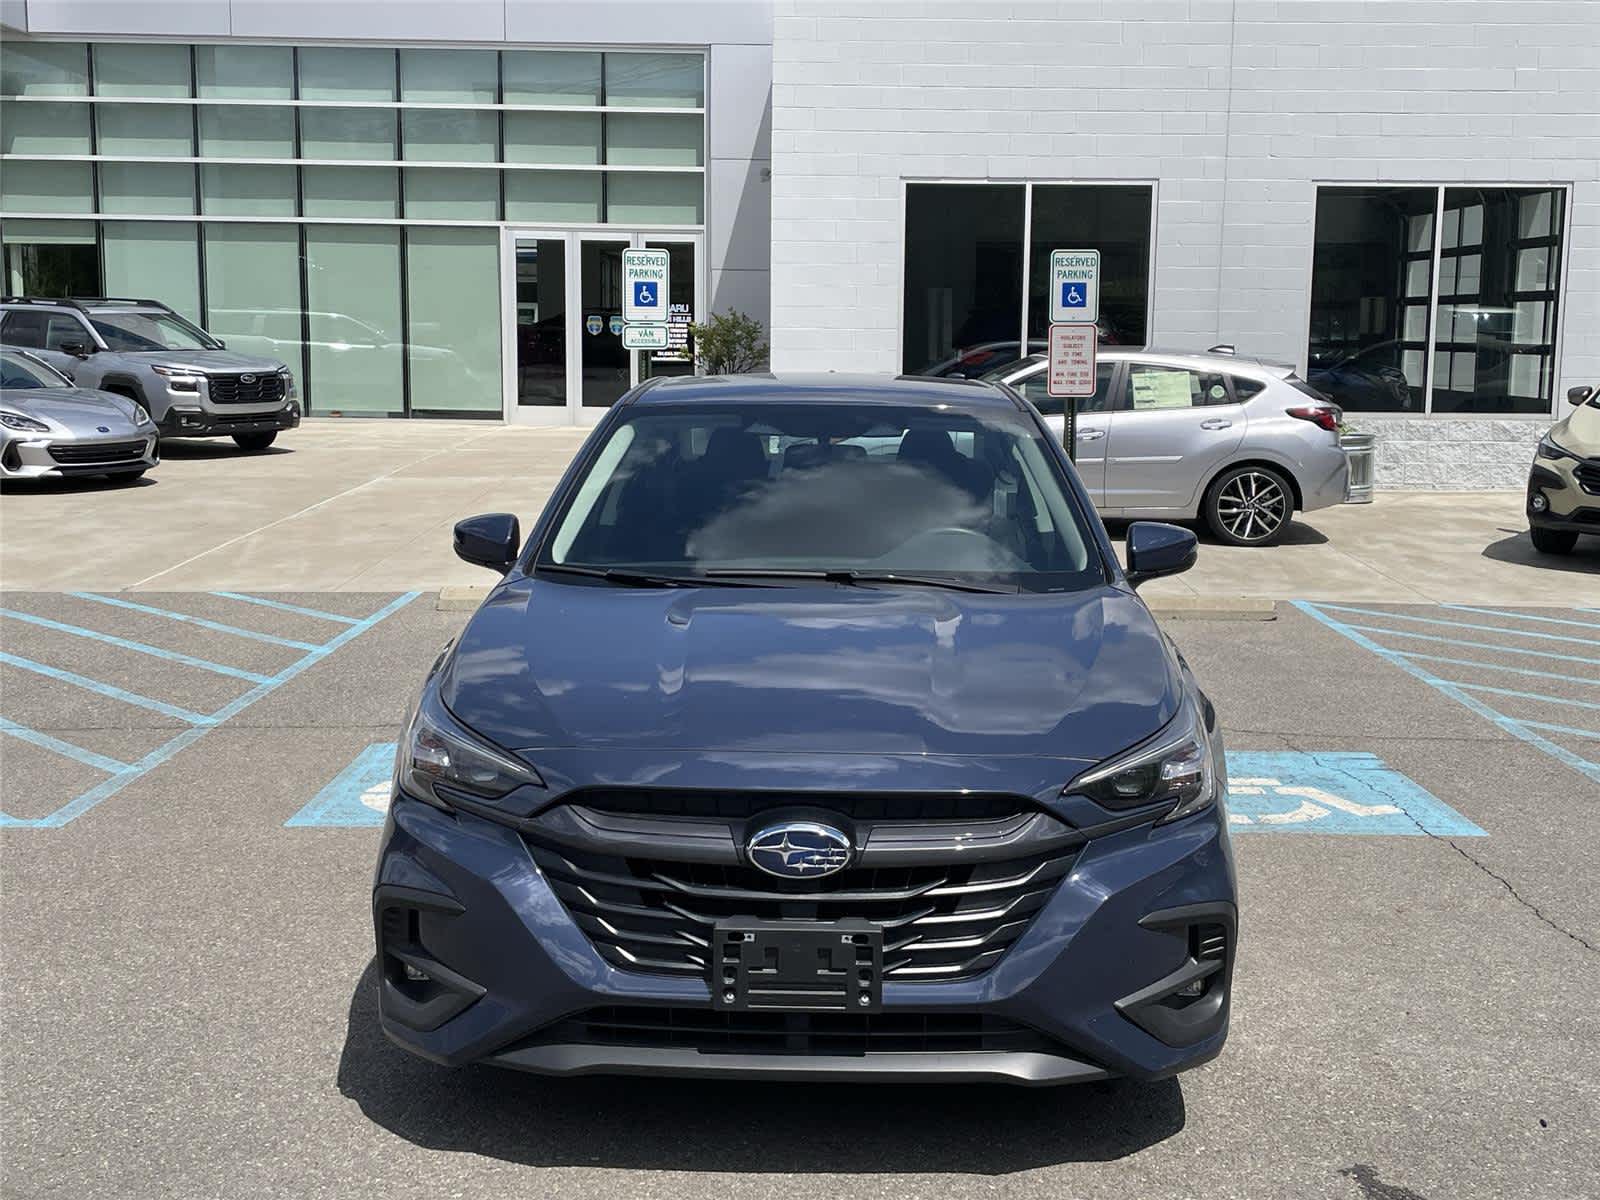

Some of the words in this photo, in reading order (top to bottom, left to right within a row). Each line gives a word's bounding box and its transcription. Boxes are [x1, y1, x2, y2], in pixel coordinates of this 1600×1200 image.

[627, 256, 666, 266] RESERVED
[1055, 257, 1097, 267] RESERVED
[629, 269, 664, 279] PARKING
[1057, 269, 1093, 280] PARKING
[669, 303, 689, 313] ARU
[638, 329, 654, 338] VAN
